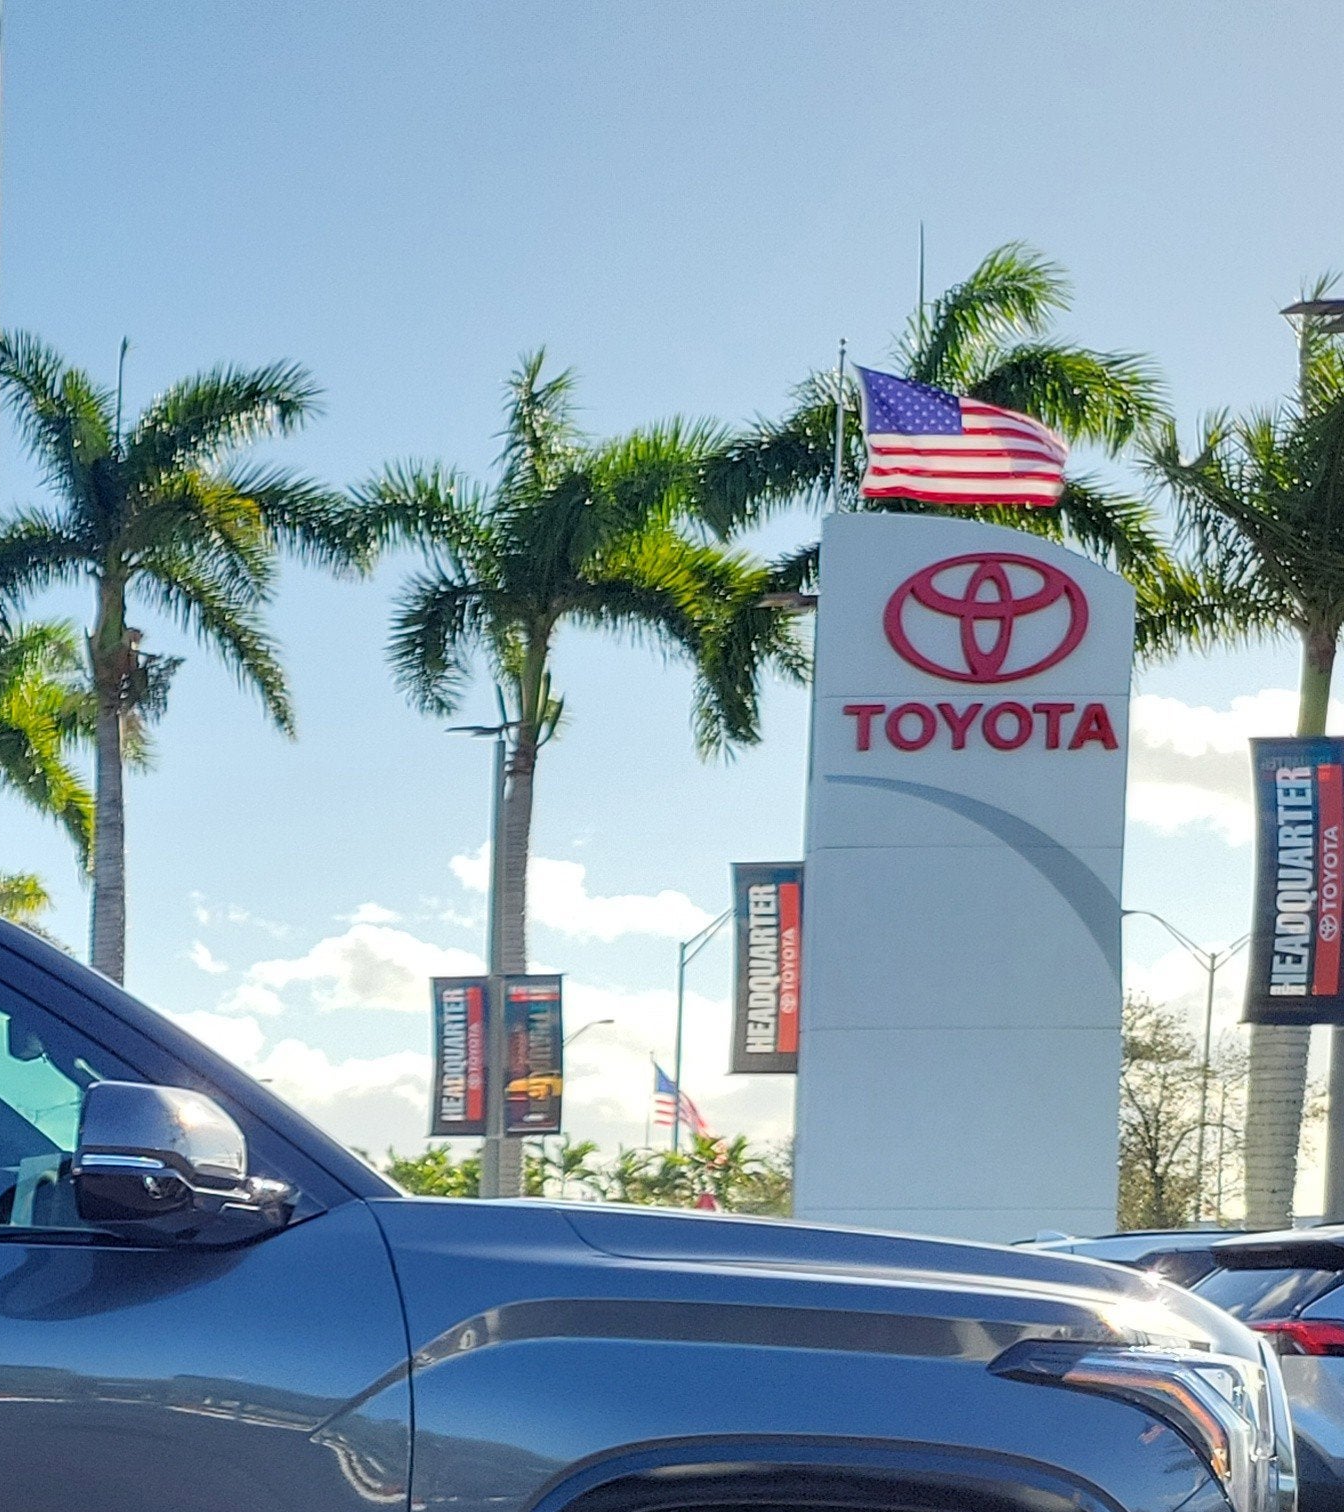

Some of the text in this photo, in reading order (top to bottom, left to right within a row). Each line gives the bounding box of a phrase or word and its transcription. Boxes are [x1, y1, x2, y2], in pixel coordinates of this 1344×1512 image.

[843, 701, 1120, 752] TOYOTA
[1269, 765, 1317, 996] HEADQUARTER
[1321, 826, 1339, 912] TOYOTA
[746, 883, 781, 1053] HEADQUARTER
[441, 988, 467, 1121] HEADQUARTER
